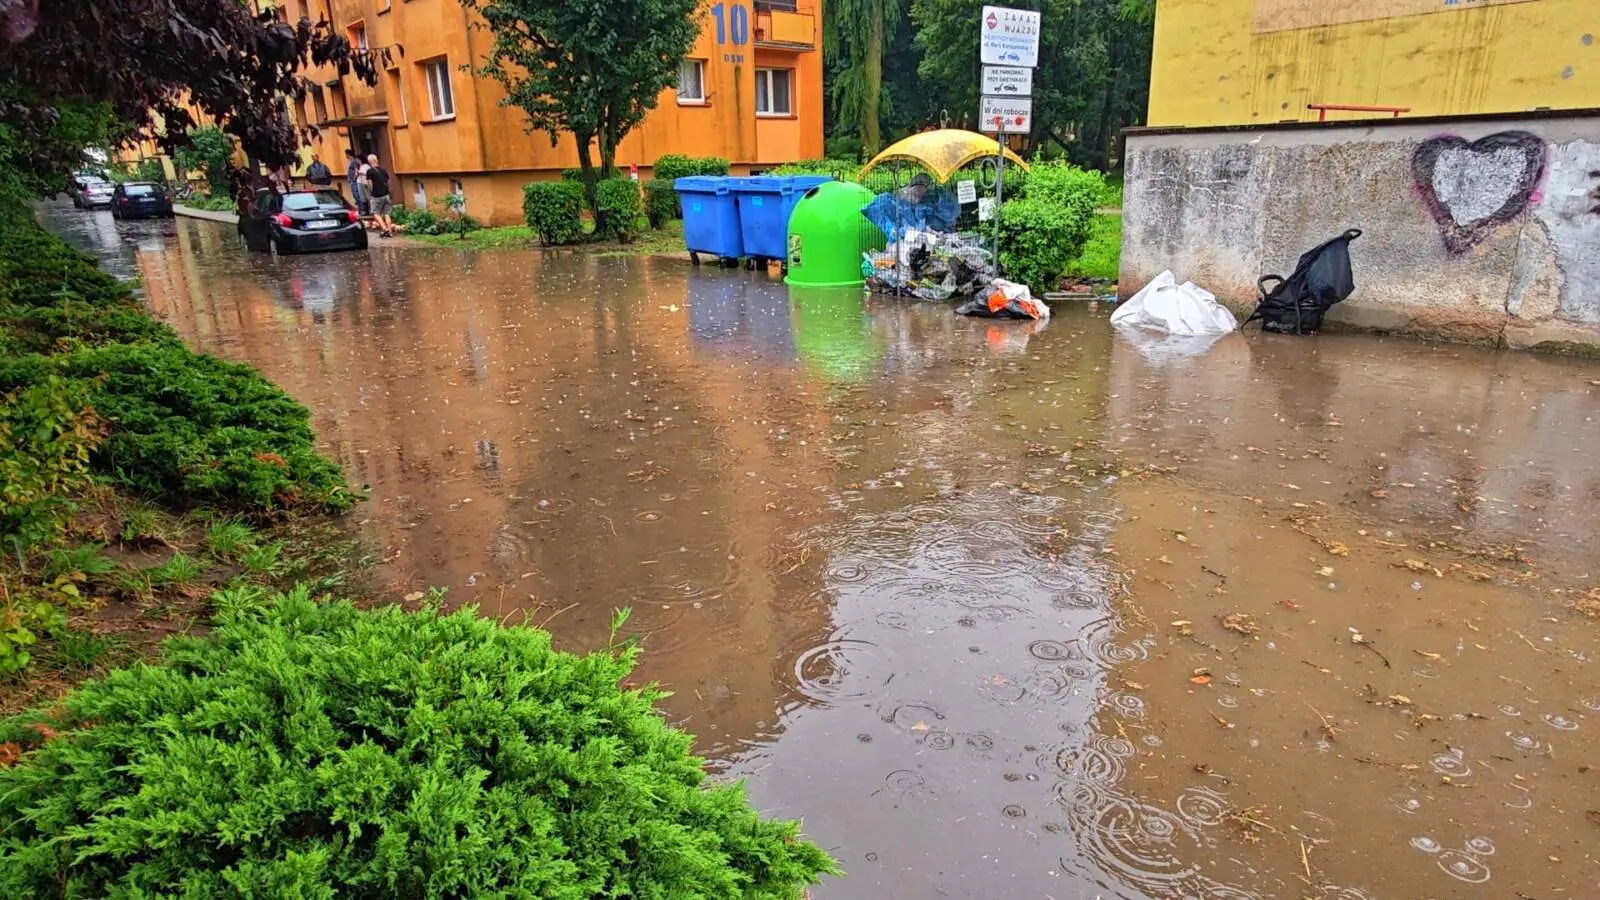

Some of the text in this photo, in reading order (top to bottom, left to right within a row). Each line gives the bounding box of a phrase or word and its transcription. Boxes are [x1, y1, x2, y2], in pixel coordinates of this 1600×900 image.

[1005, 12, 1036, 24] ZAKAZ
[711, 3, 748, 45] 10
[1005, 24, 1037, 35] WJAZDU
[992, 107, 1003, 115] dni
[1004, 108, 1029, 116] robocze
